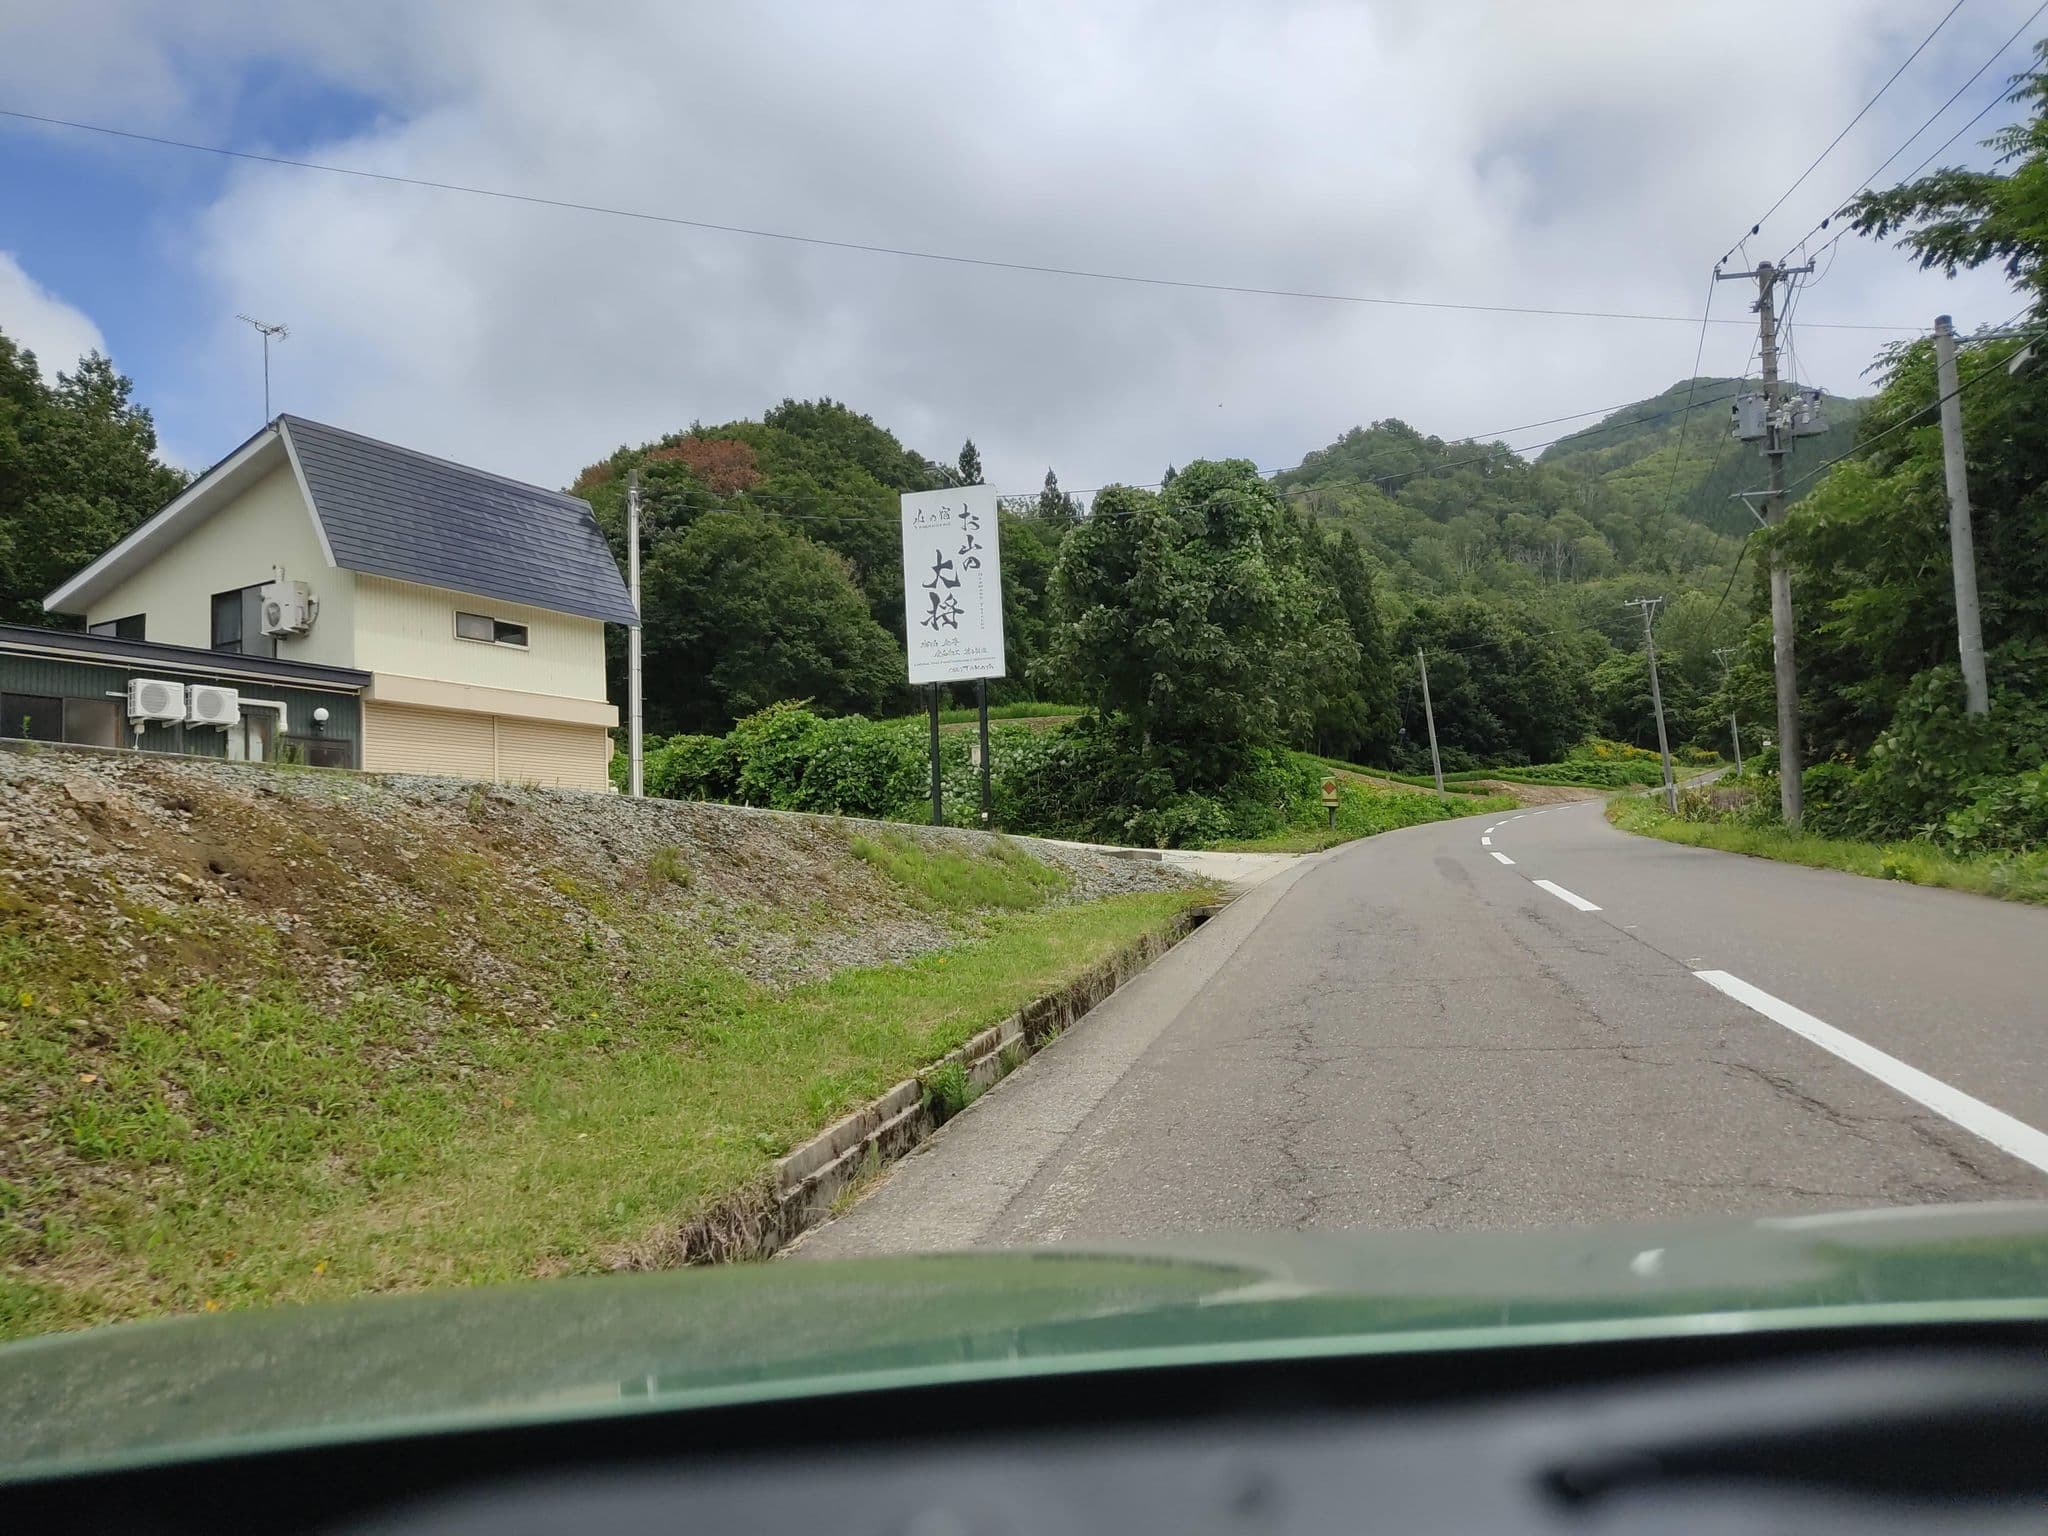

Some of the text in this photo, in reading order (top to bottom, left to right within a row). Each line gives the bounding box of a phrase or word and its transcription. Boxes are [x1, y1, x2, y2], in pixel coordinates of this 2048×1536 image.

[958, 503, 983, 571] お山の
[920, 549, 965, 631] 大将
